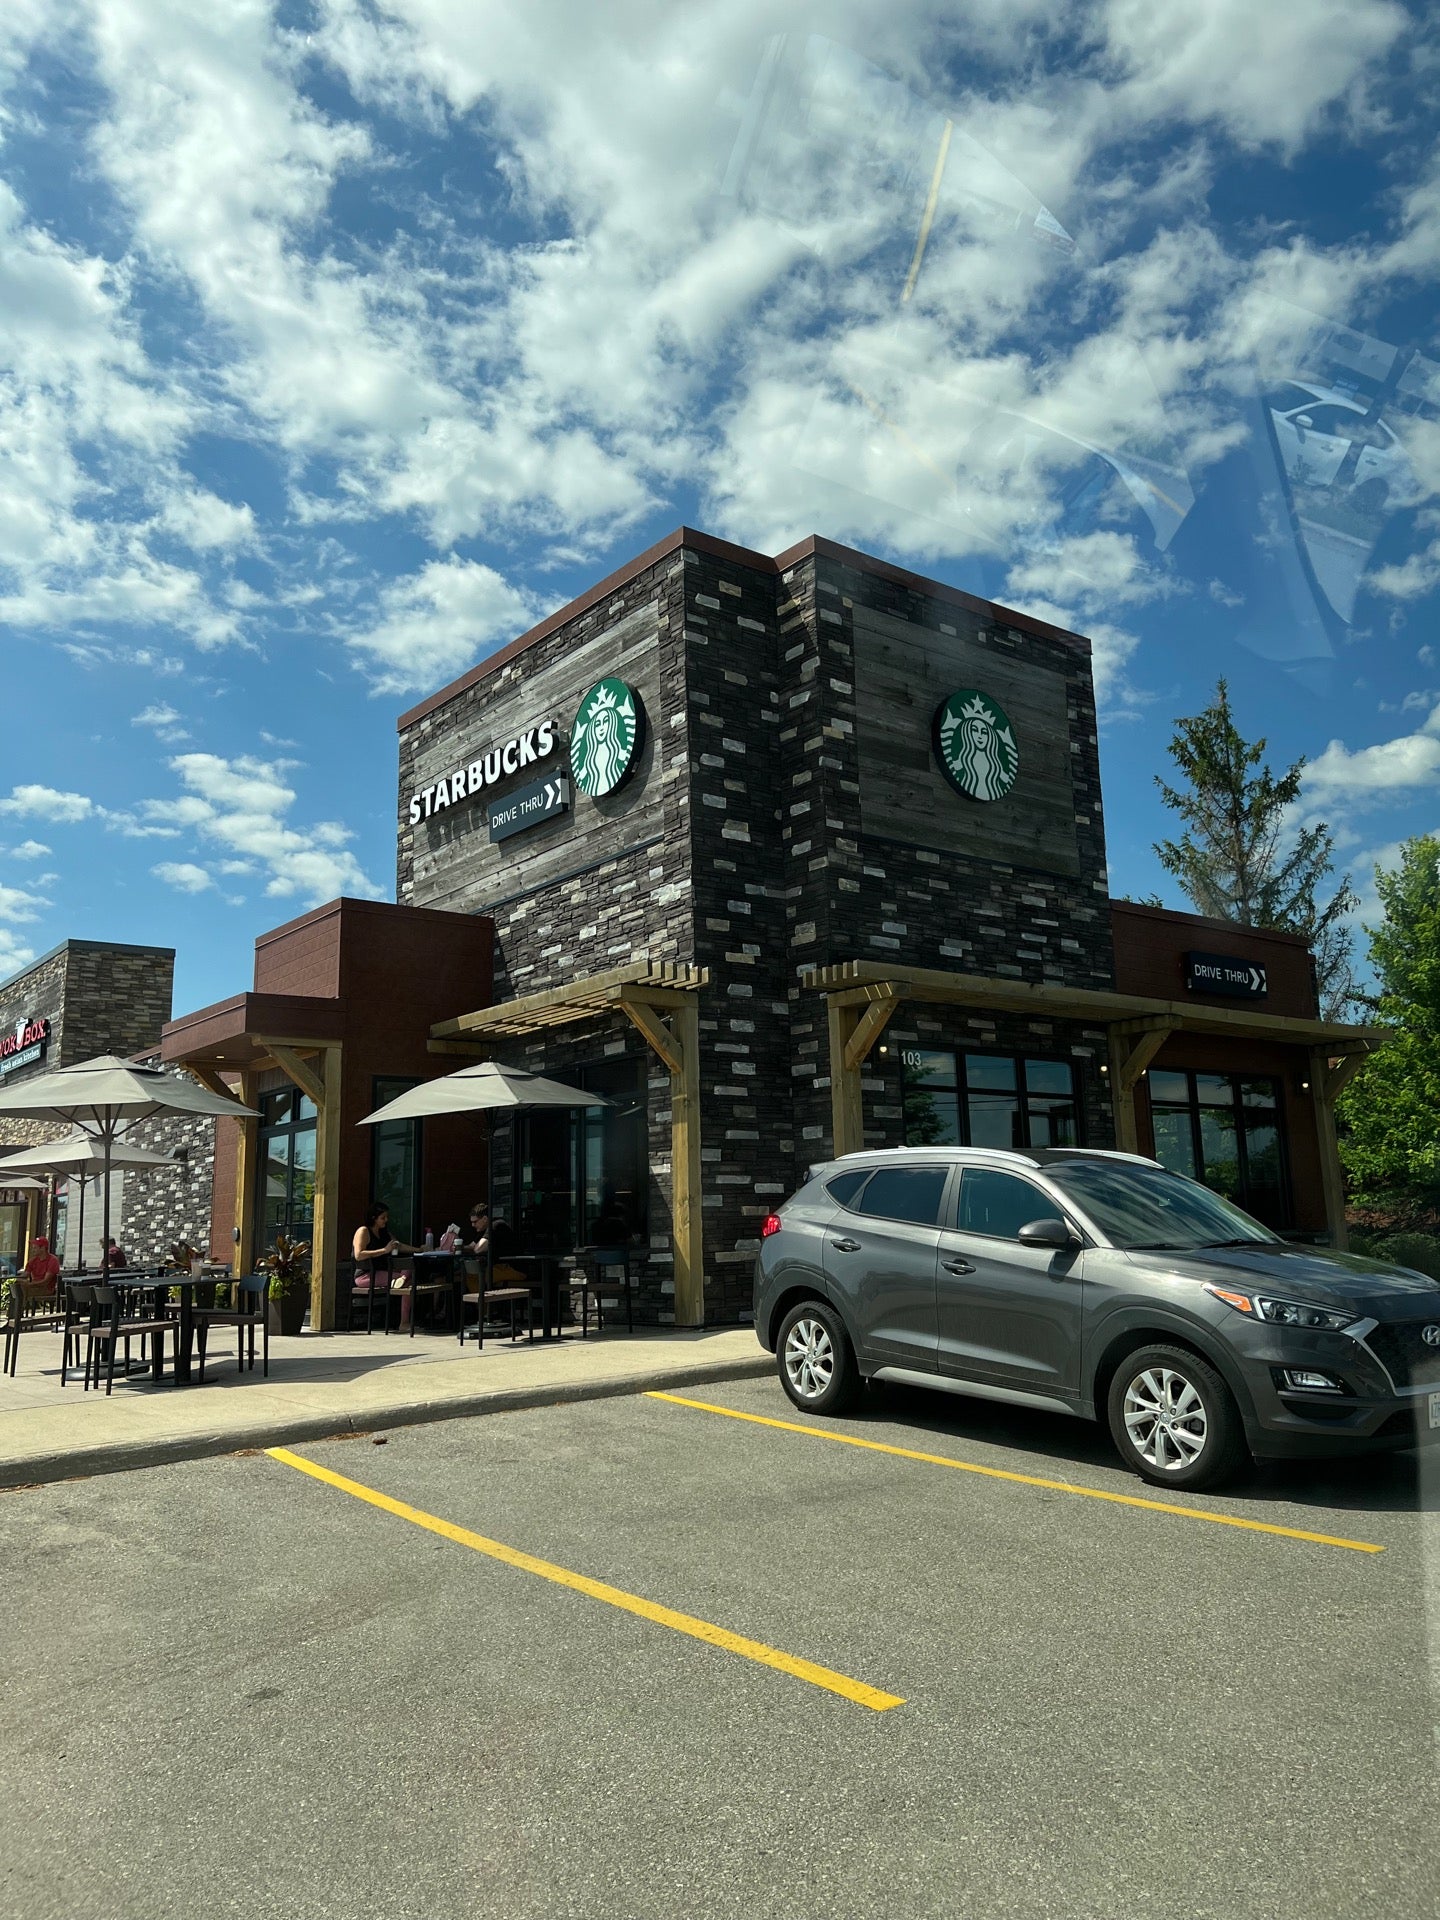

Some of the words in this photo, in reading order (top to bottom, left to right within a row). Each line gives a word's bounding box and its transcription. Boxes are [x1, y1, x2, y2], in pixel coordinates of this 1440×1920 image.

[409, 721, 556, 824] STARBUCKS
[492, 806, 518, 829] DRIVE
[519, 793, 544, 815] THRU
[1194, 964, 1222, 980] DRIVE
[1224, 968, 1249, 984] THRU
[901, 1051, 921, 1066] 103
